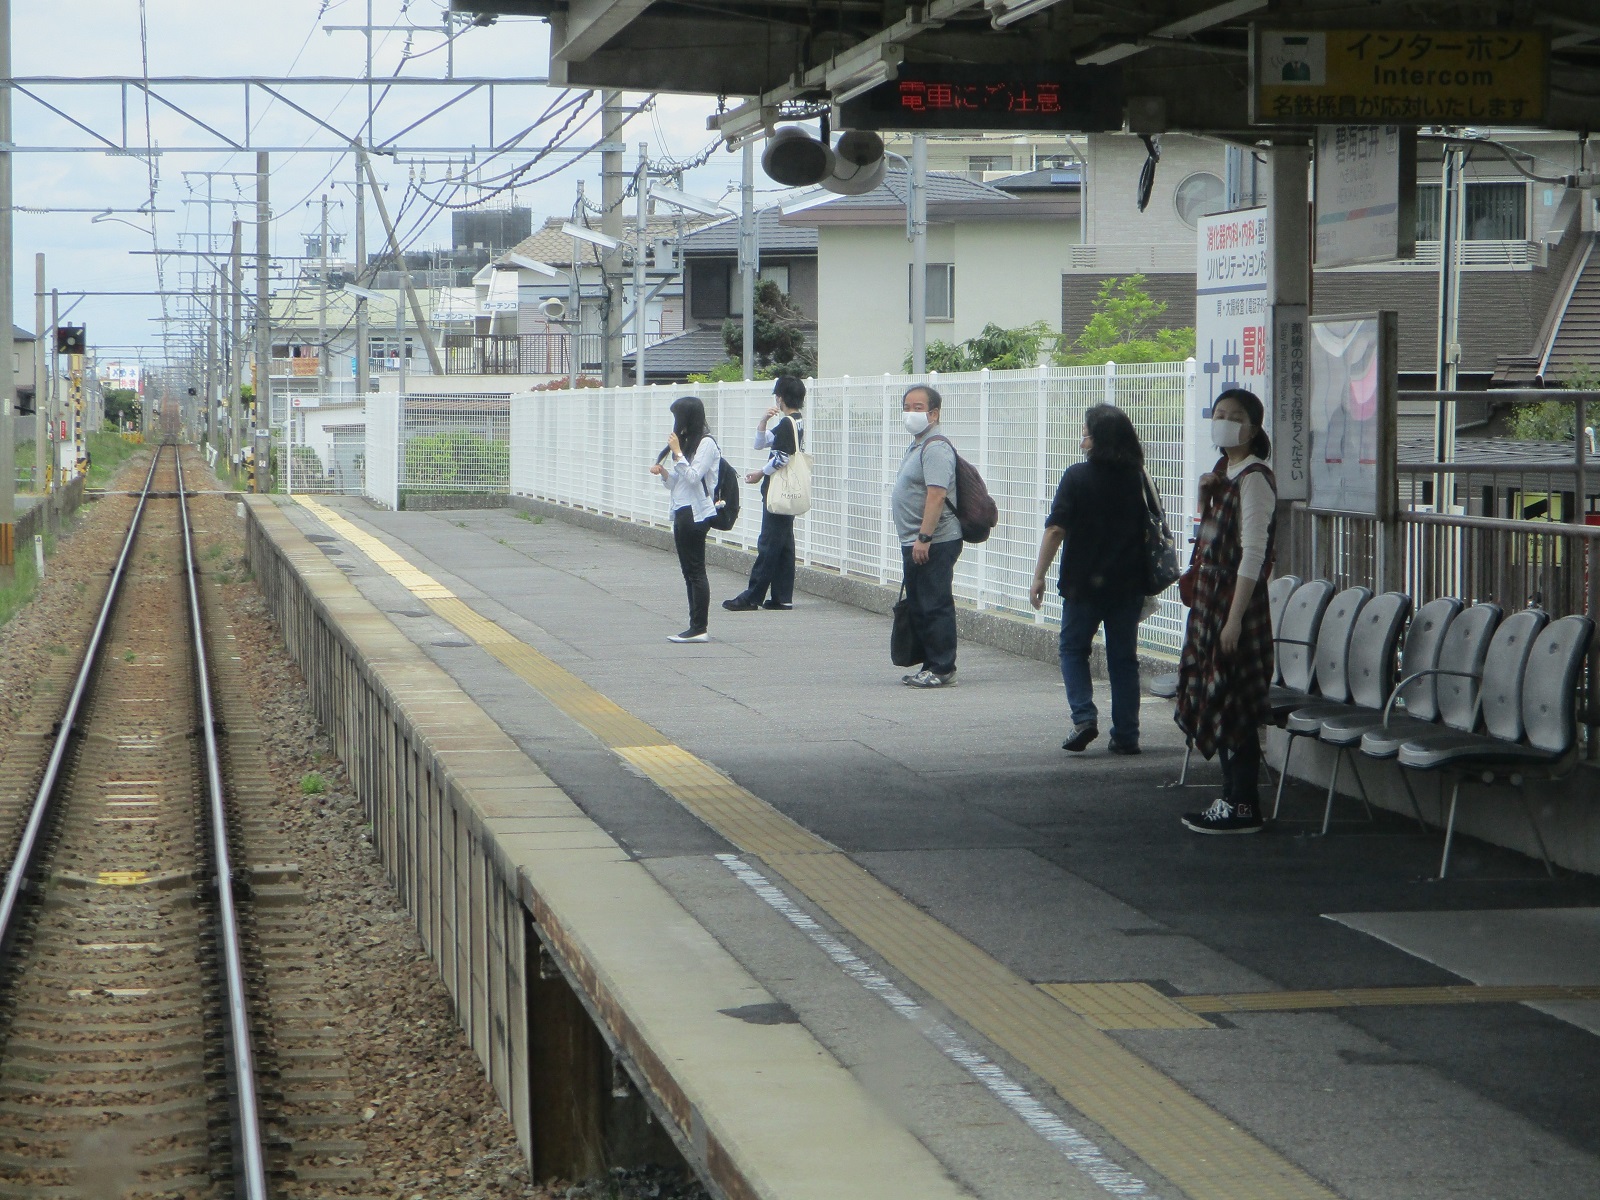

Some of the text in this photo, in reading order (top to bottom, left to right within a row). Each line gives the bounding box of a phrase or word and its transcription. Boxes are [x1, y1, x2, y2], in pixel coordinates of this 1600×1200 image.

[1347, 33, 1523, 61] インターホン
[1374, 66, 1493, 86] Intercom
[900, 82, 1061, 111] 電車にご注意
[1273, 94, 1527, 118] 名鉄係員が応対いたします
[1207, 218, 1267, 251] 消化器内科・内科・整
[1280, 322, 1288, 341] Stay
[1280, 344, 1288, 373] Behind
[1280, 376, 1288, 401] Yellow
